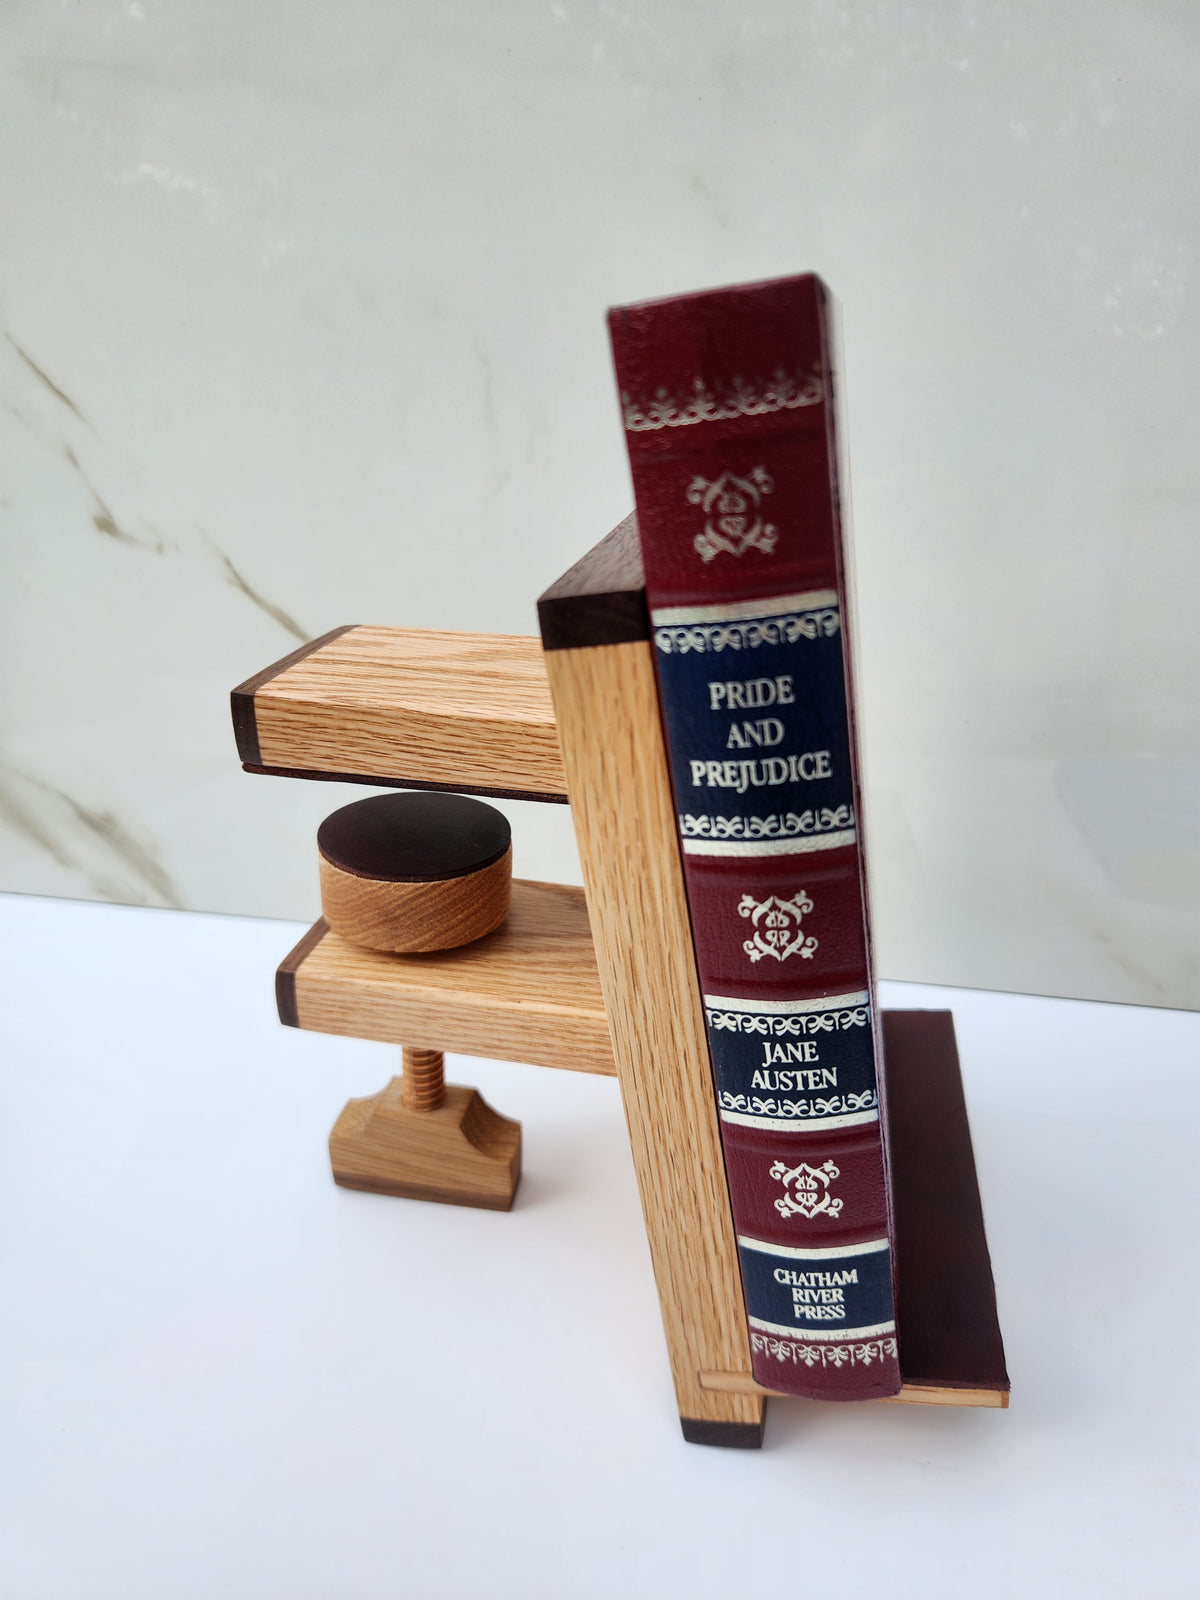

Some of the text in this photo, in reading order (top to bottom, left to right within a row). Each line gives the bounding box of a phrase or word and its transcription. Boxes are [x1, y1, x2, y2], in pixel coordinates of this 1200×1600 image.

[707, 674, 797, 711] PRIDE
[726, 717, 785, 749] AND
[688, 749, 833, 794] PREJUDICE
[762, 1040, 820, 1068] JANE
[750, 1066, 838, 1092] AUSTEN
[773, 1268, 859, 1287] CHATHAM
[791, 1287, 846, 1304] RIVER
[793, 1303, 847, 1320] PRESS
